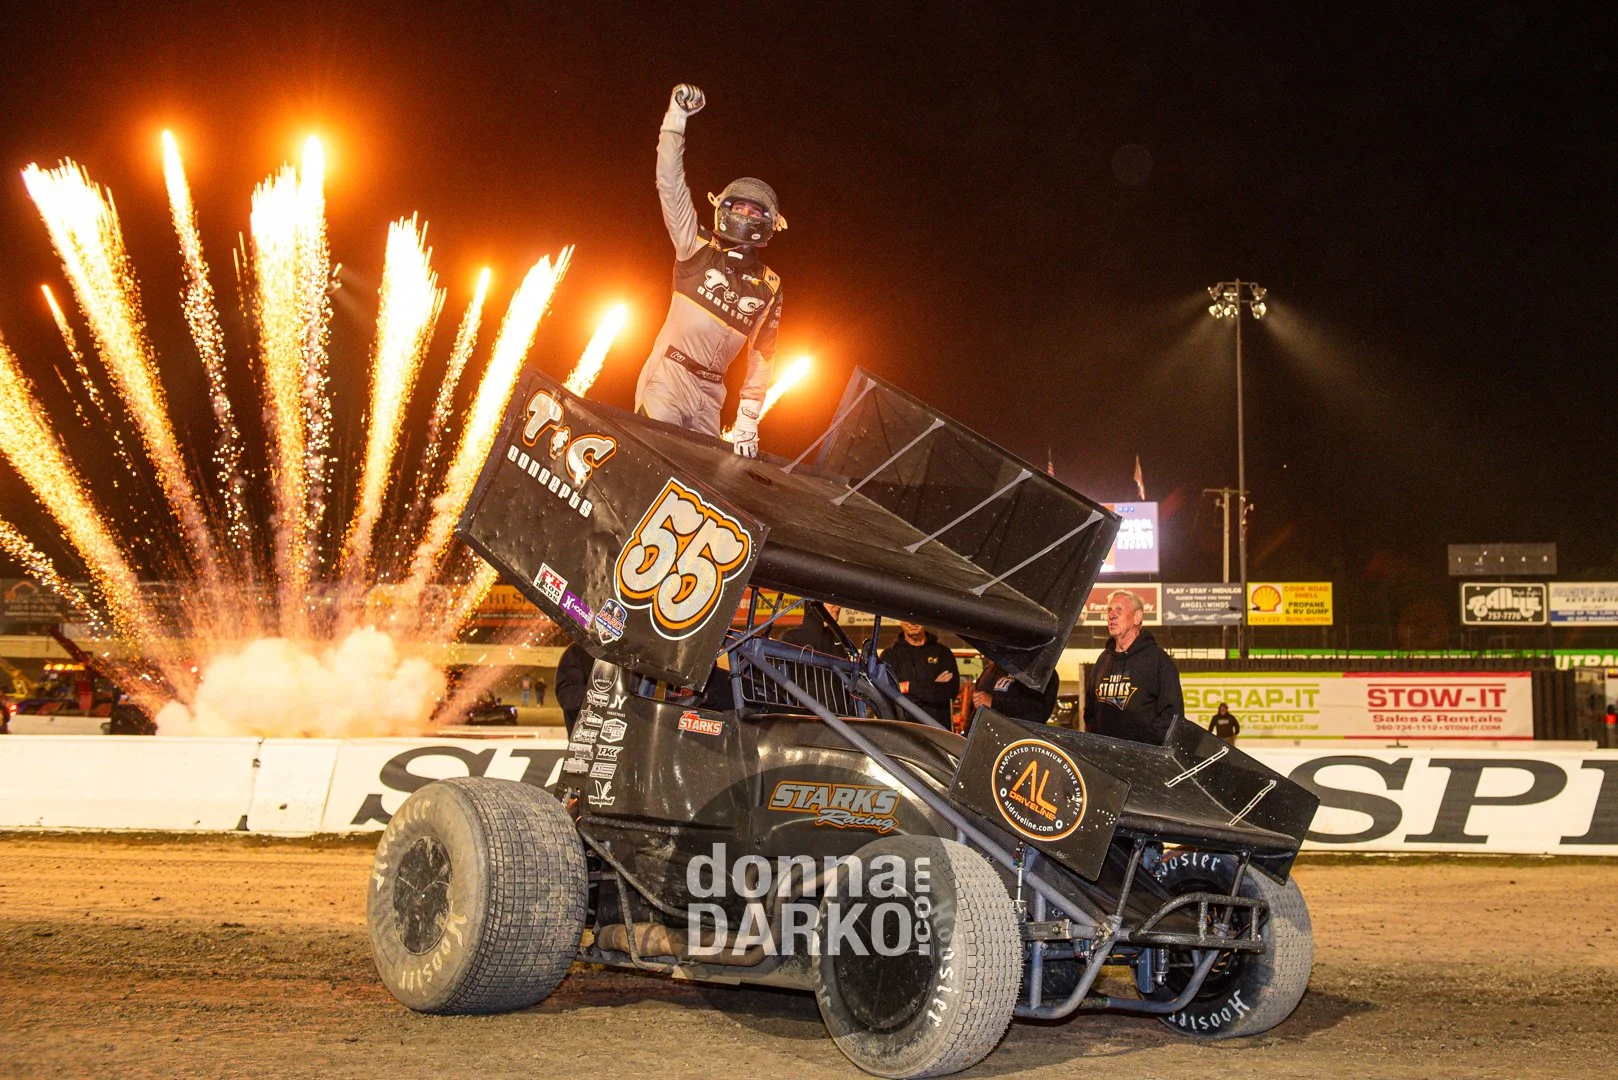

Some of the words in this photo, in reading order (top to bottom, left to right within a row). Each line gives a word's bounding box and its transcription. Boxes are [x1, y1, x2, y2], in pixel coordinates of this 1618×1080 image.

[616, 479, 751, 636] 55
[542, 569, 564, 591] FK
[1182, 688, 1320, 708] SCRAP-IT
[1367, 688, 1506, 708] STOW-IT
[680, 717, 721, 734] STARKS
[1372, 714, 1418, 723] Sales
[1421, 714, 1432, 723] &
[1436, 714, 1503, 723] Rentals
[1030, 746, 1062, 765] TITANIUM
[1062, 762, 1078, 785] DRIVE
[771, 784, 898, 814] STARKS
[1008, 791, 1057, 822] DRIVELINE
[817, 808, 897, 831] Racing
[1004, 800, 1054, 832] aldriveline.com
